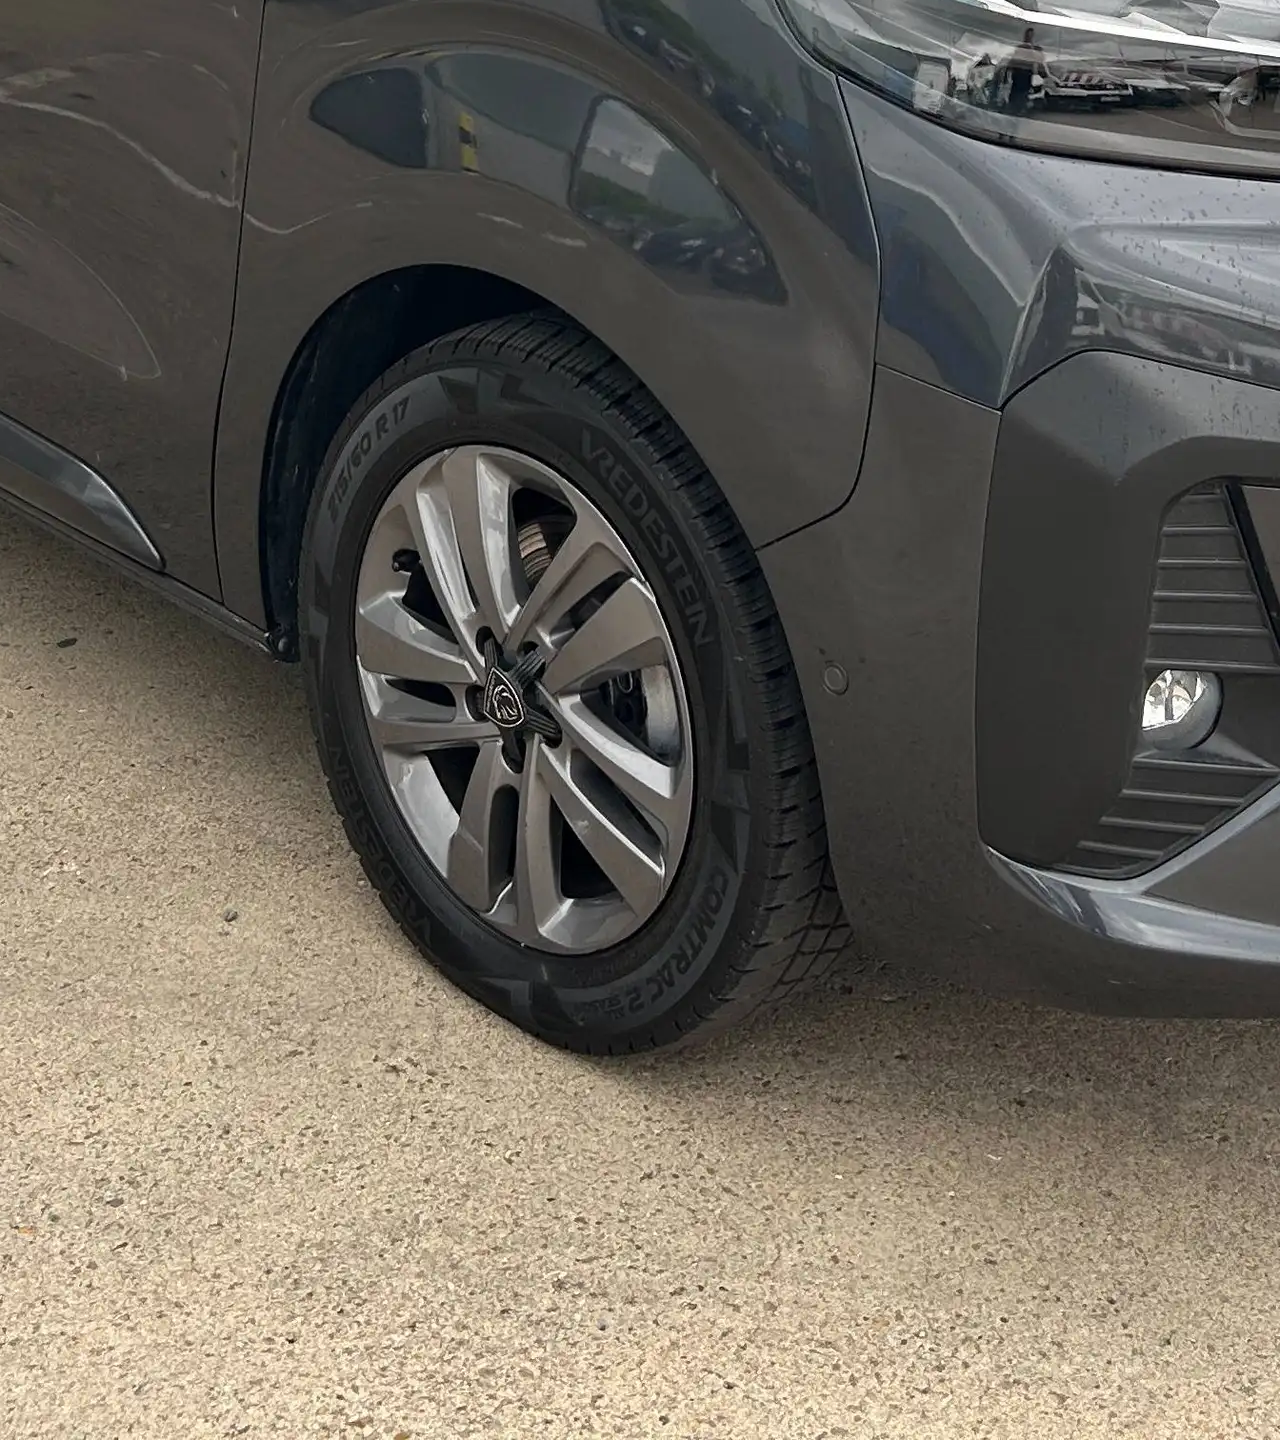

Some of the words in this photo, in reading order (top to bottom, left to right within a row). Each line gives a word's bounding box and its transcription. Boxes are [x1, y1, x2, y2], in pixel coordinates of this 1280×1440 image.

[376, 413, 389, 441] R
[393, 396, 411, 425] 17
[581, 427, 714, 647] VREDESTEIN
[646, 865, 729, 1000] COMTRAC
